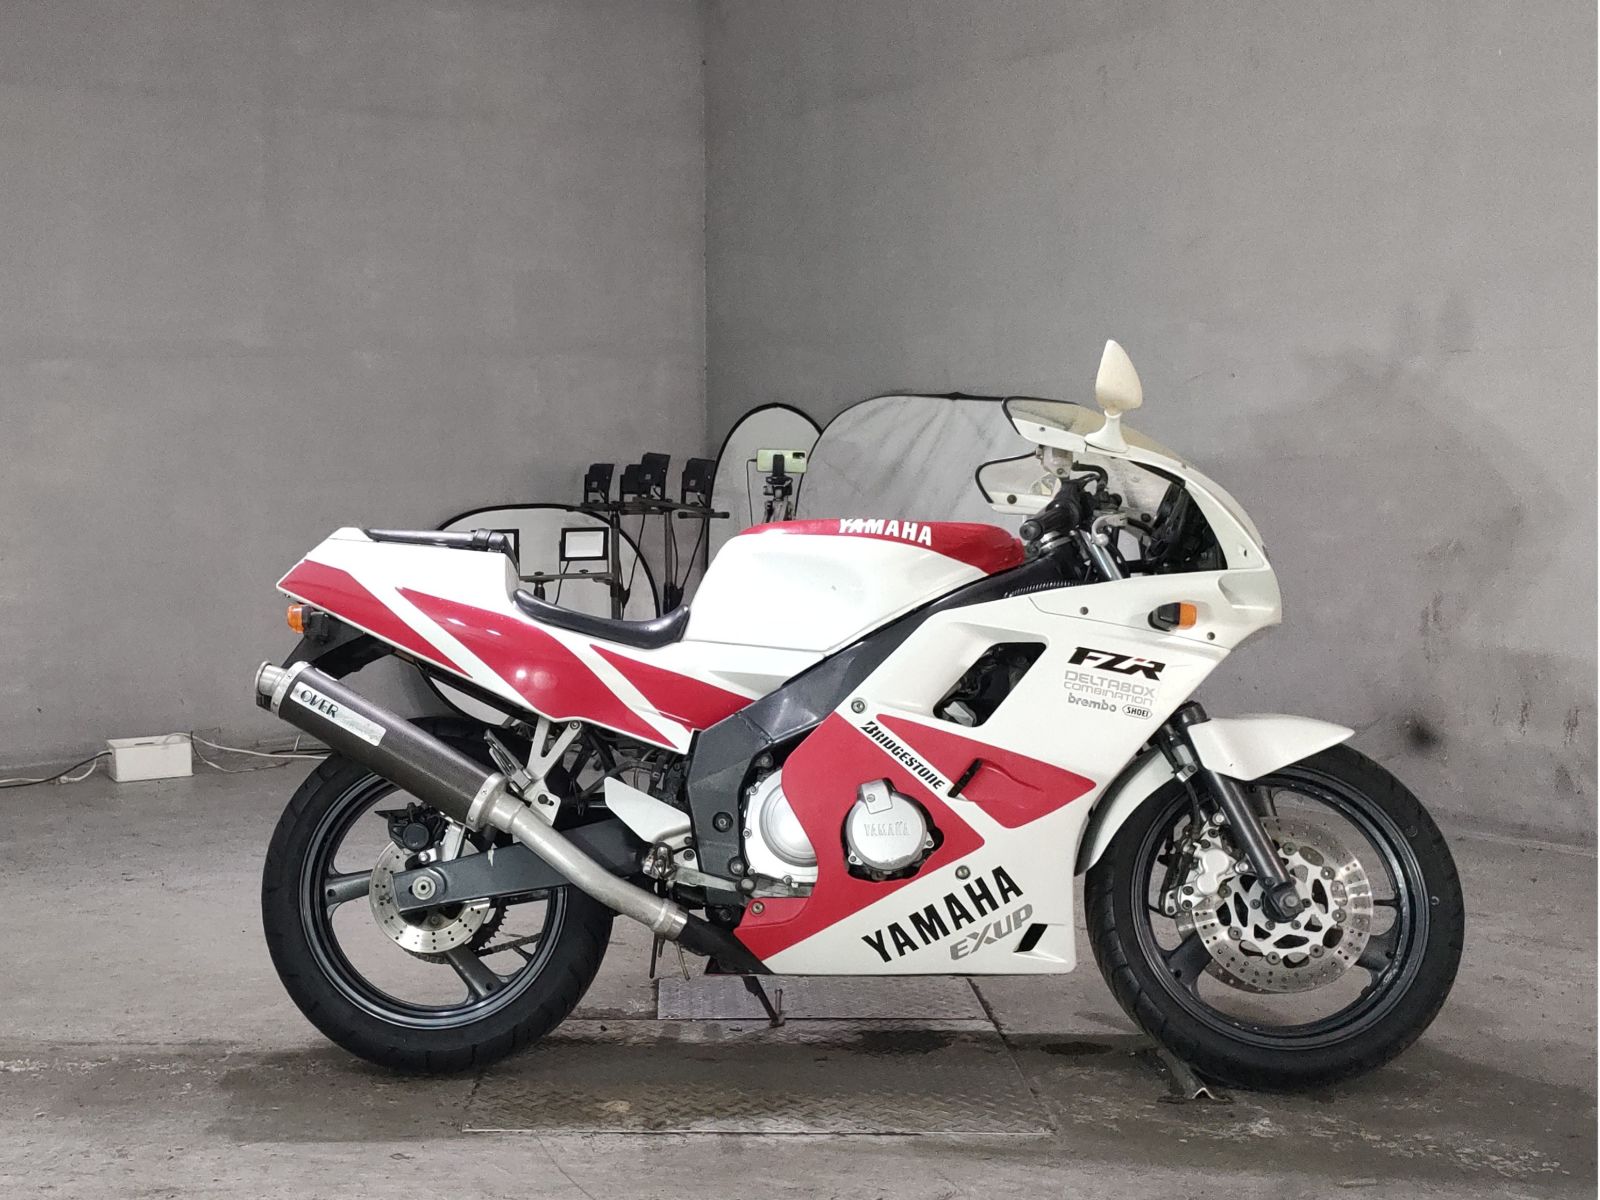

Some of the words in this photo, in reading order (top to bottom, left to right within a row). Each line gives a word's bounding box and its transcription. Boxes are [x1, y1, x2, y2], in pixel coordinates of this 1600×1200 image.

[839, 518, 932, 547] YAMAHA
[1067, 646, 1167, 682] FZR
[1063, 681, 1154, 707] COMBINATION
[1064, 670, 1156, 698] DELTABOX
[300, 689, 339, 719] OVER
[1067, 692, 1117, 713] brembo
[1127, 706, 1149, 718] SHOEI
[860, 720, 946, 790] BRIDGESTONE
[861, 865, 1024, 963] YAMAHA
[949, 903, 1033, 961] EXUP
